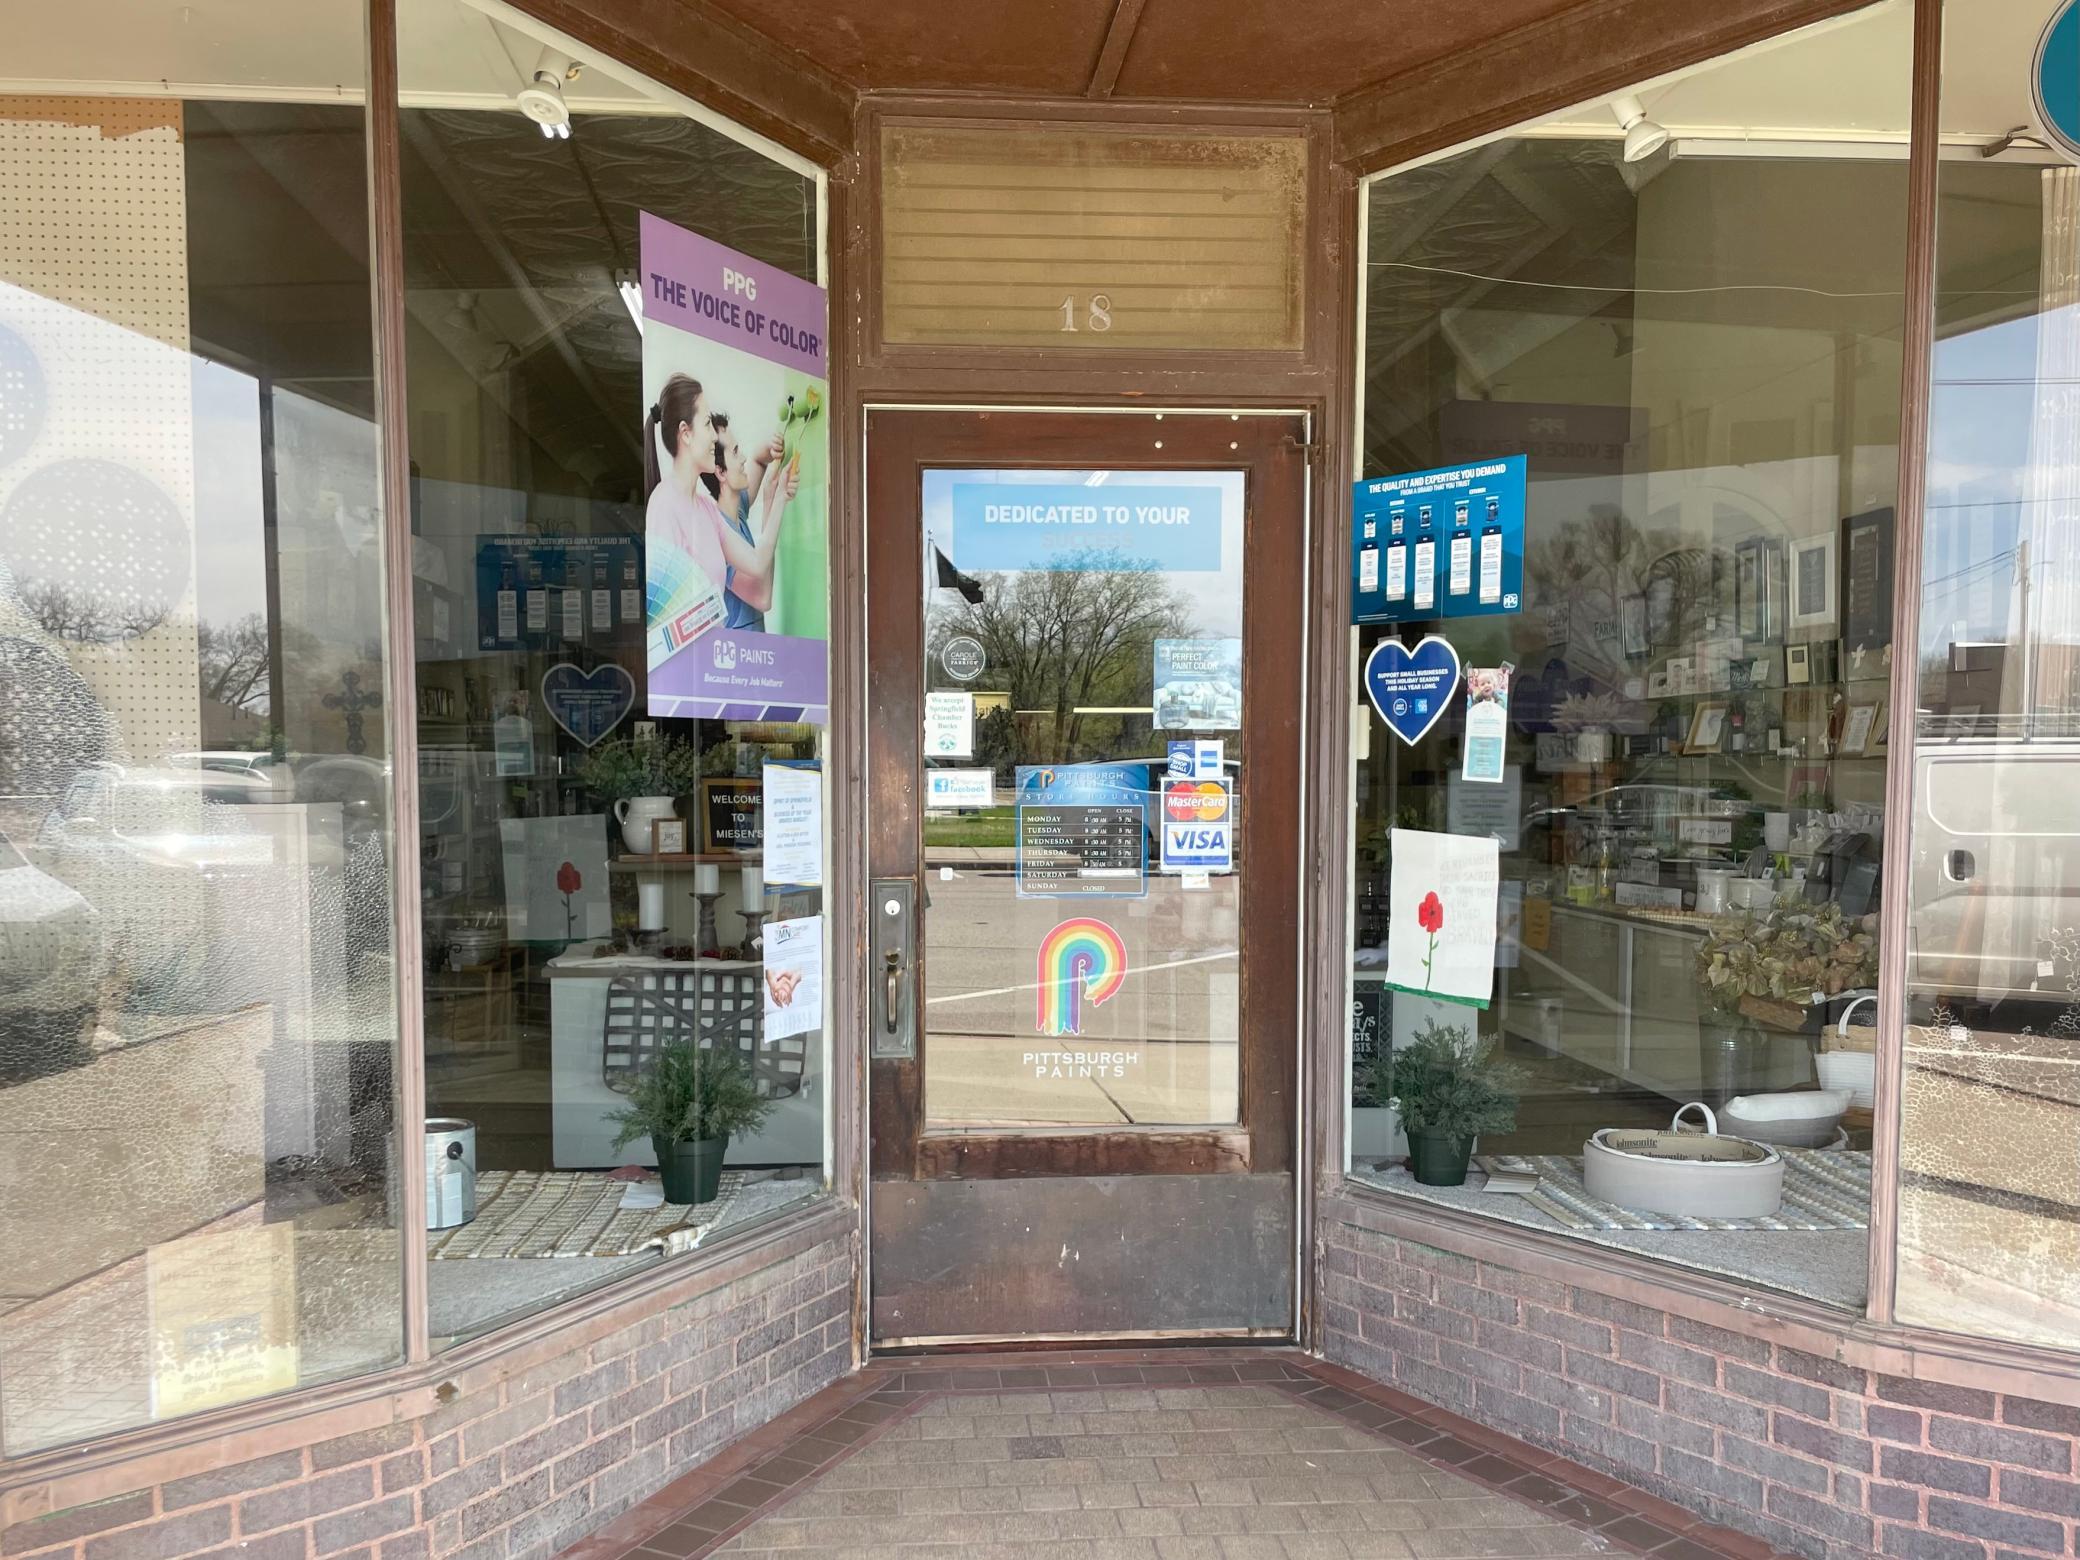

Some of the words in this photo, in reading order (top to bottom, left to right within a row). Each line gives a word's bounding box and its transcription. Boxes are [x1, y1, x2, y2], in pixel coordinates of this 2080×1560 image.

[722, 266, 757, 301] PPG
[650, 272, 687, 309] THE
[691, 287, 741, 329] VOICE
[744, 309, 766, 336] OF
[1368, 483, 1382, 494] THE
[1382, 480, 1409, 492] QUALITY
[1409, 478, 1424, 488] AND
[1424, 472, 1461, 486] EXPERTISE
[1460, 469, 1475, 480] YOU
[1475, 463, 1507, 478] DEMAND
[984, 504, 1098, 525] DEDICATED
[1103, 506, 1130, 525] TO
[1136, 506, 1191, 525] YOUR
[739, 648, 775, 665] PAINTS
[1172, 652, 1202, 661] PERFECT
[1171, 661, 1192, 670] PAINT
[1193, 661, 1218, 670] COLOR
[1057, 771, 1125, 780] PITTSBURGH
[950, 784, 986, 793] facebook
[712, 794, 762, 804] WELCOME
[1167, 796, 1226, 808] MasterCard
[731, 812, 745, 822] TO
[716, 829, 764, 839] MIESEN'S
[1170, 830, 1226, 850] VISA
[1023, 1052, 1138, 1065] PITTSBURGH
[1035, 1066, 1125, 1079] PAINTS
